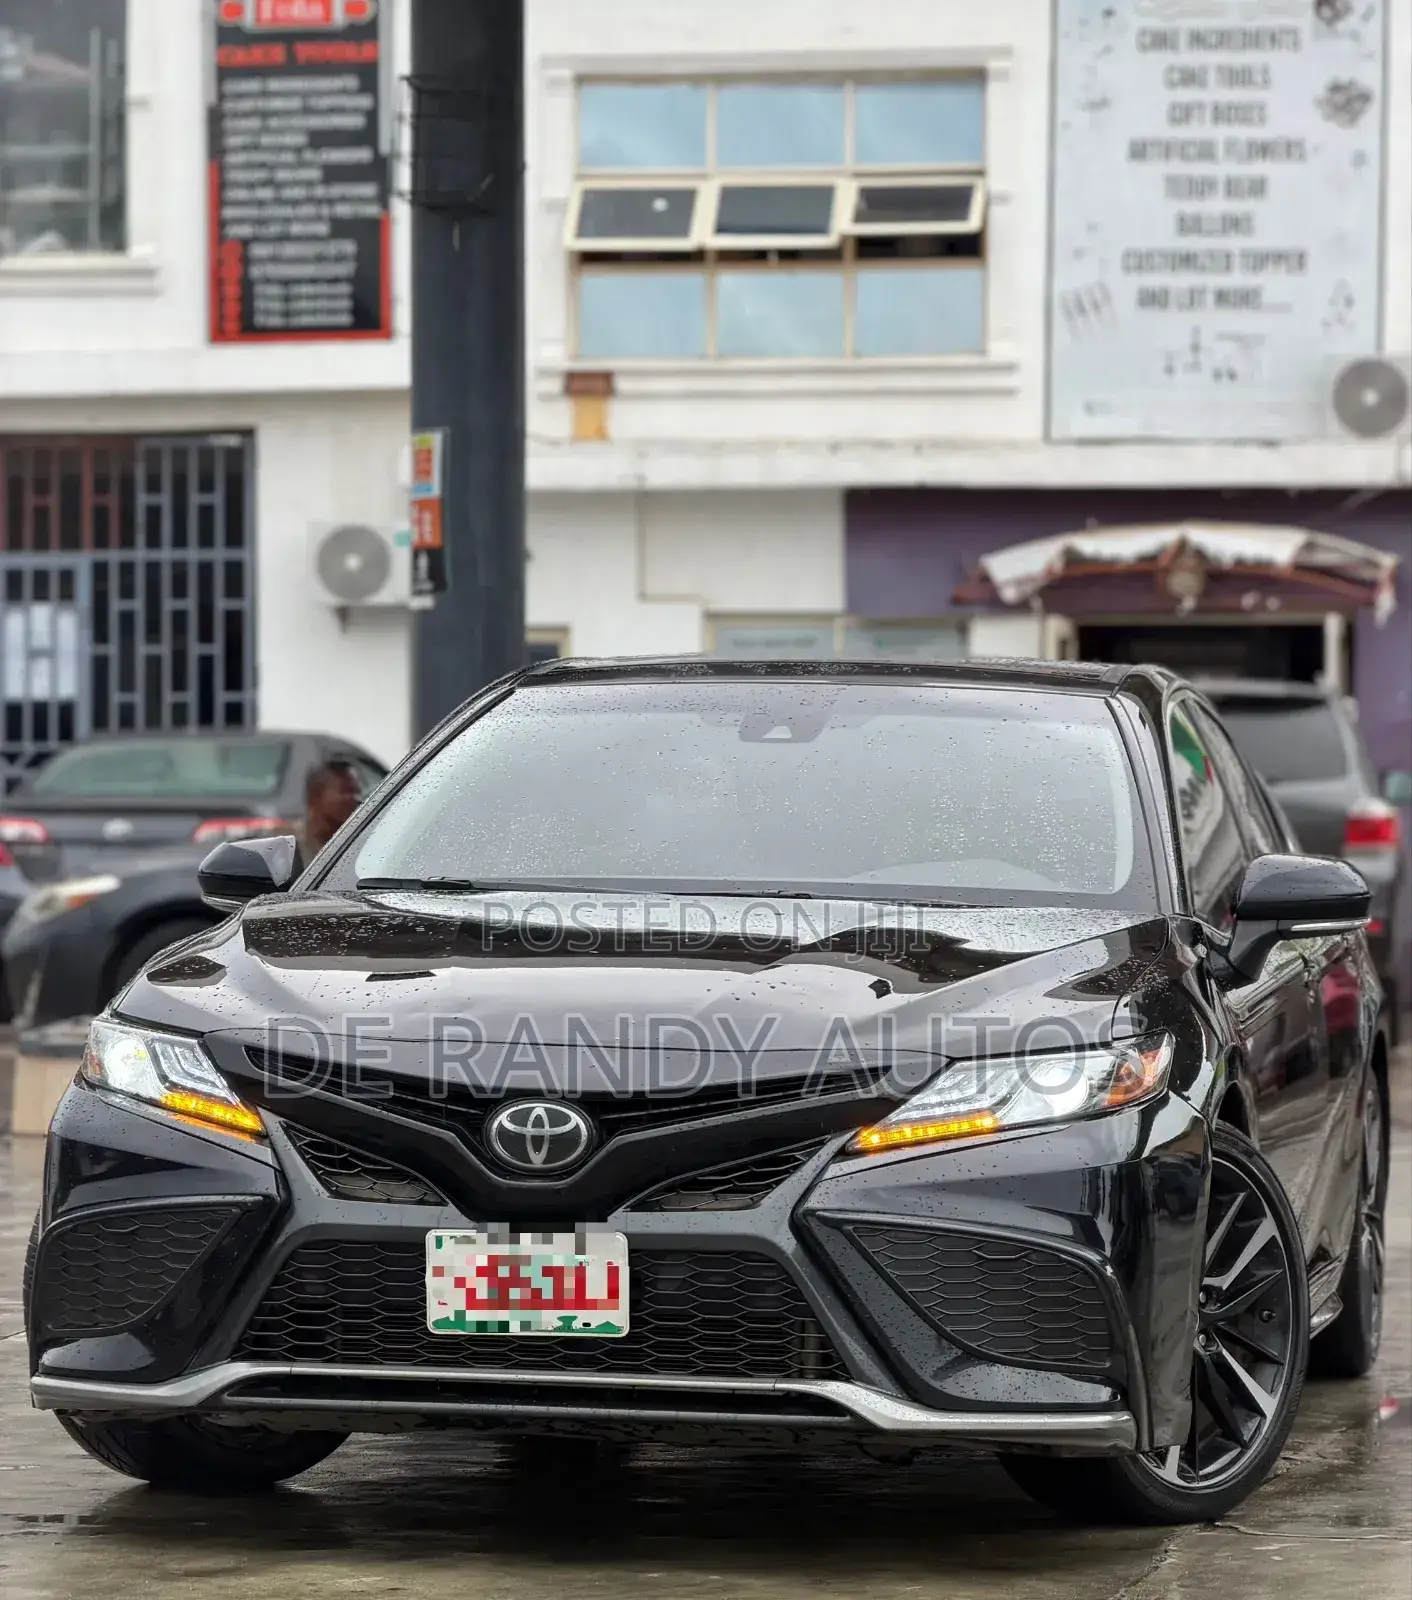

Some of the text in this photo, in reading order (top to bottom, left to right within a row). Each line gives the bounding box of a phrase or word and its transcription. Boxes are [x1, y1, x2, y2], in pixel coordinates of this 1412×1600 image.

[1163, 63, 1272, 90] CAKE TOOLS
[1166, 101, 1267, 127] GIFT BOXES
[1223, 137, 1307, 163] FLOWERS
